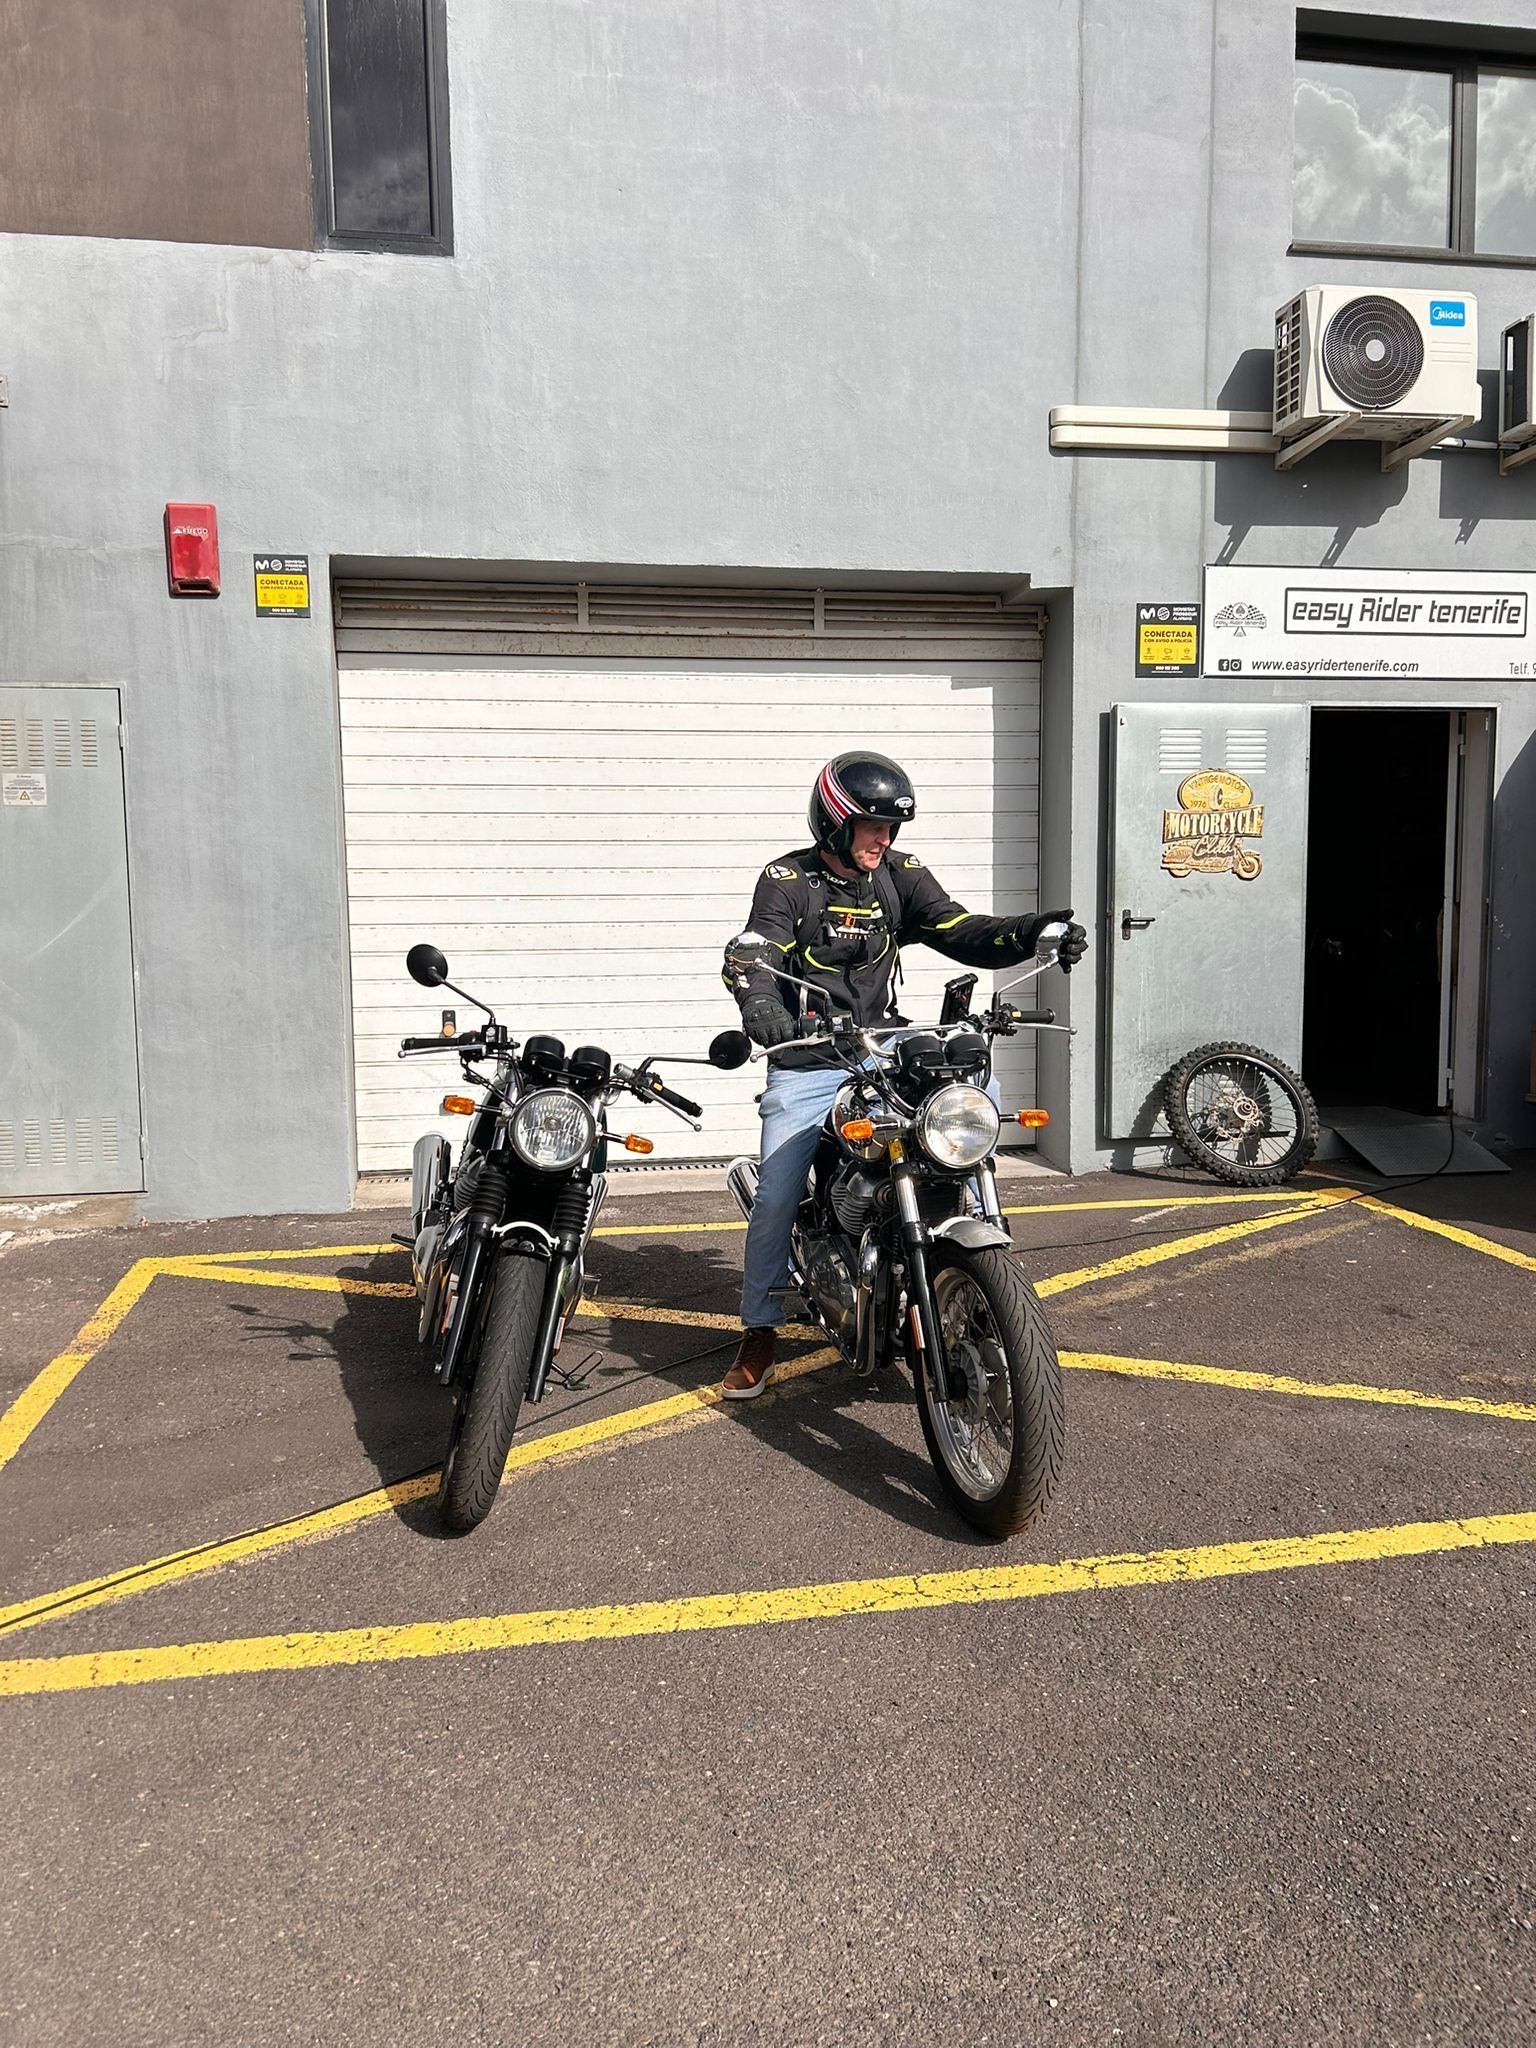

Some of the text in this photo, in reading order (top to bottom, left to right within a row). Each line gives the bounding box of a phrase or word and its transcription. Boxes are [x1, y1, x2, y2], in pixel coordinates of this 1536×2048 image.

[1436, 308, 1463, 320] Midea
[1292, 597, 1521, 628] easy Rider tenerife
[1251, 658, 1419, 674] www.easyridertenerife.com
[1509, 662, 1529, 675] Telf.
[1168, 807, 1262, 839] MOTORCYCLE
[1194, 835, 1235, 856] Club
